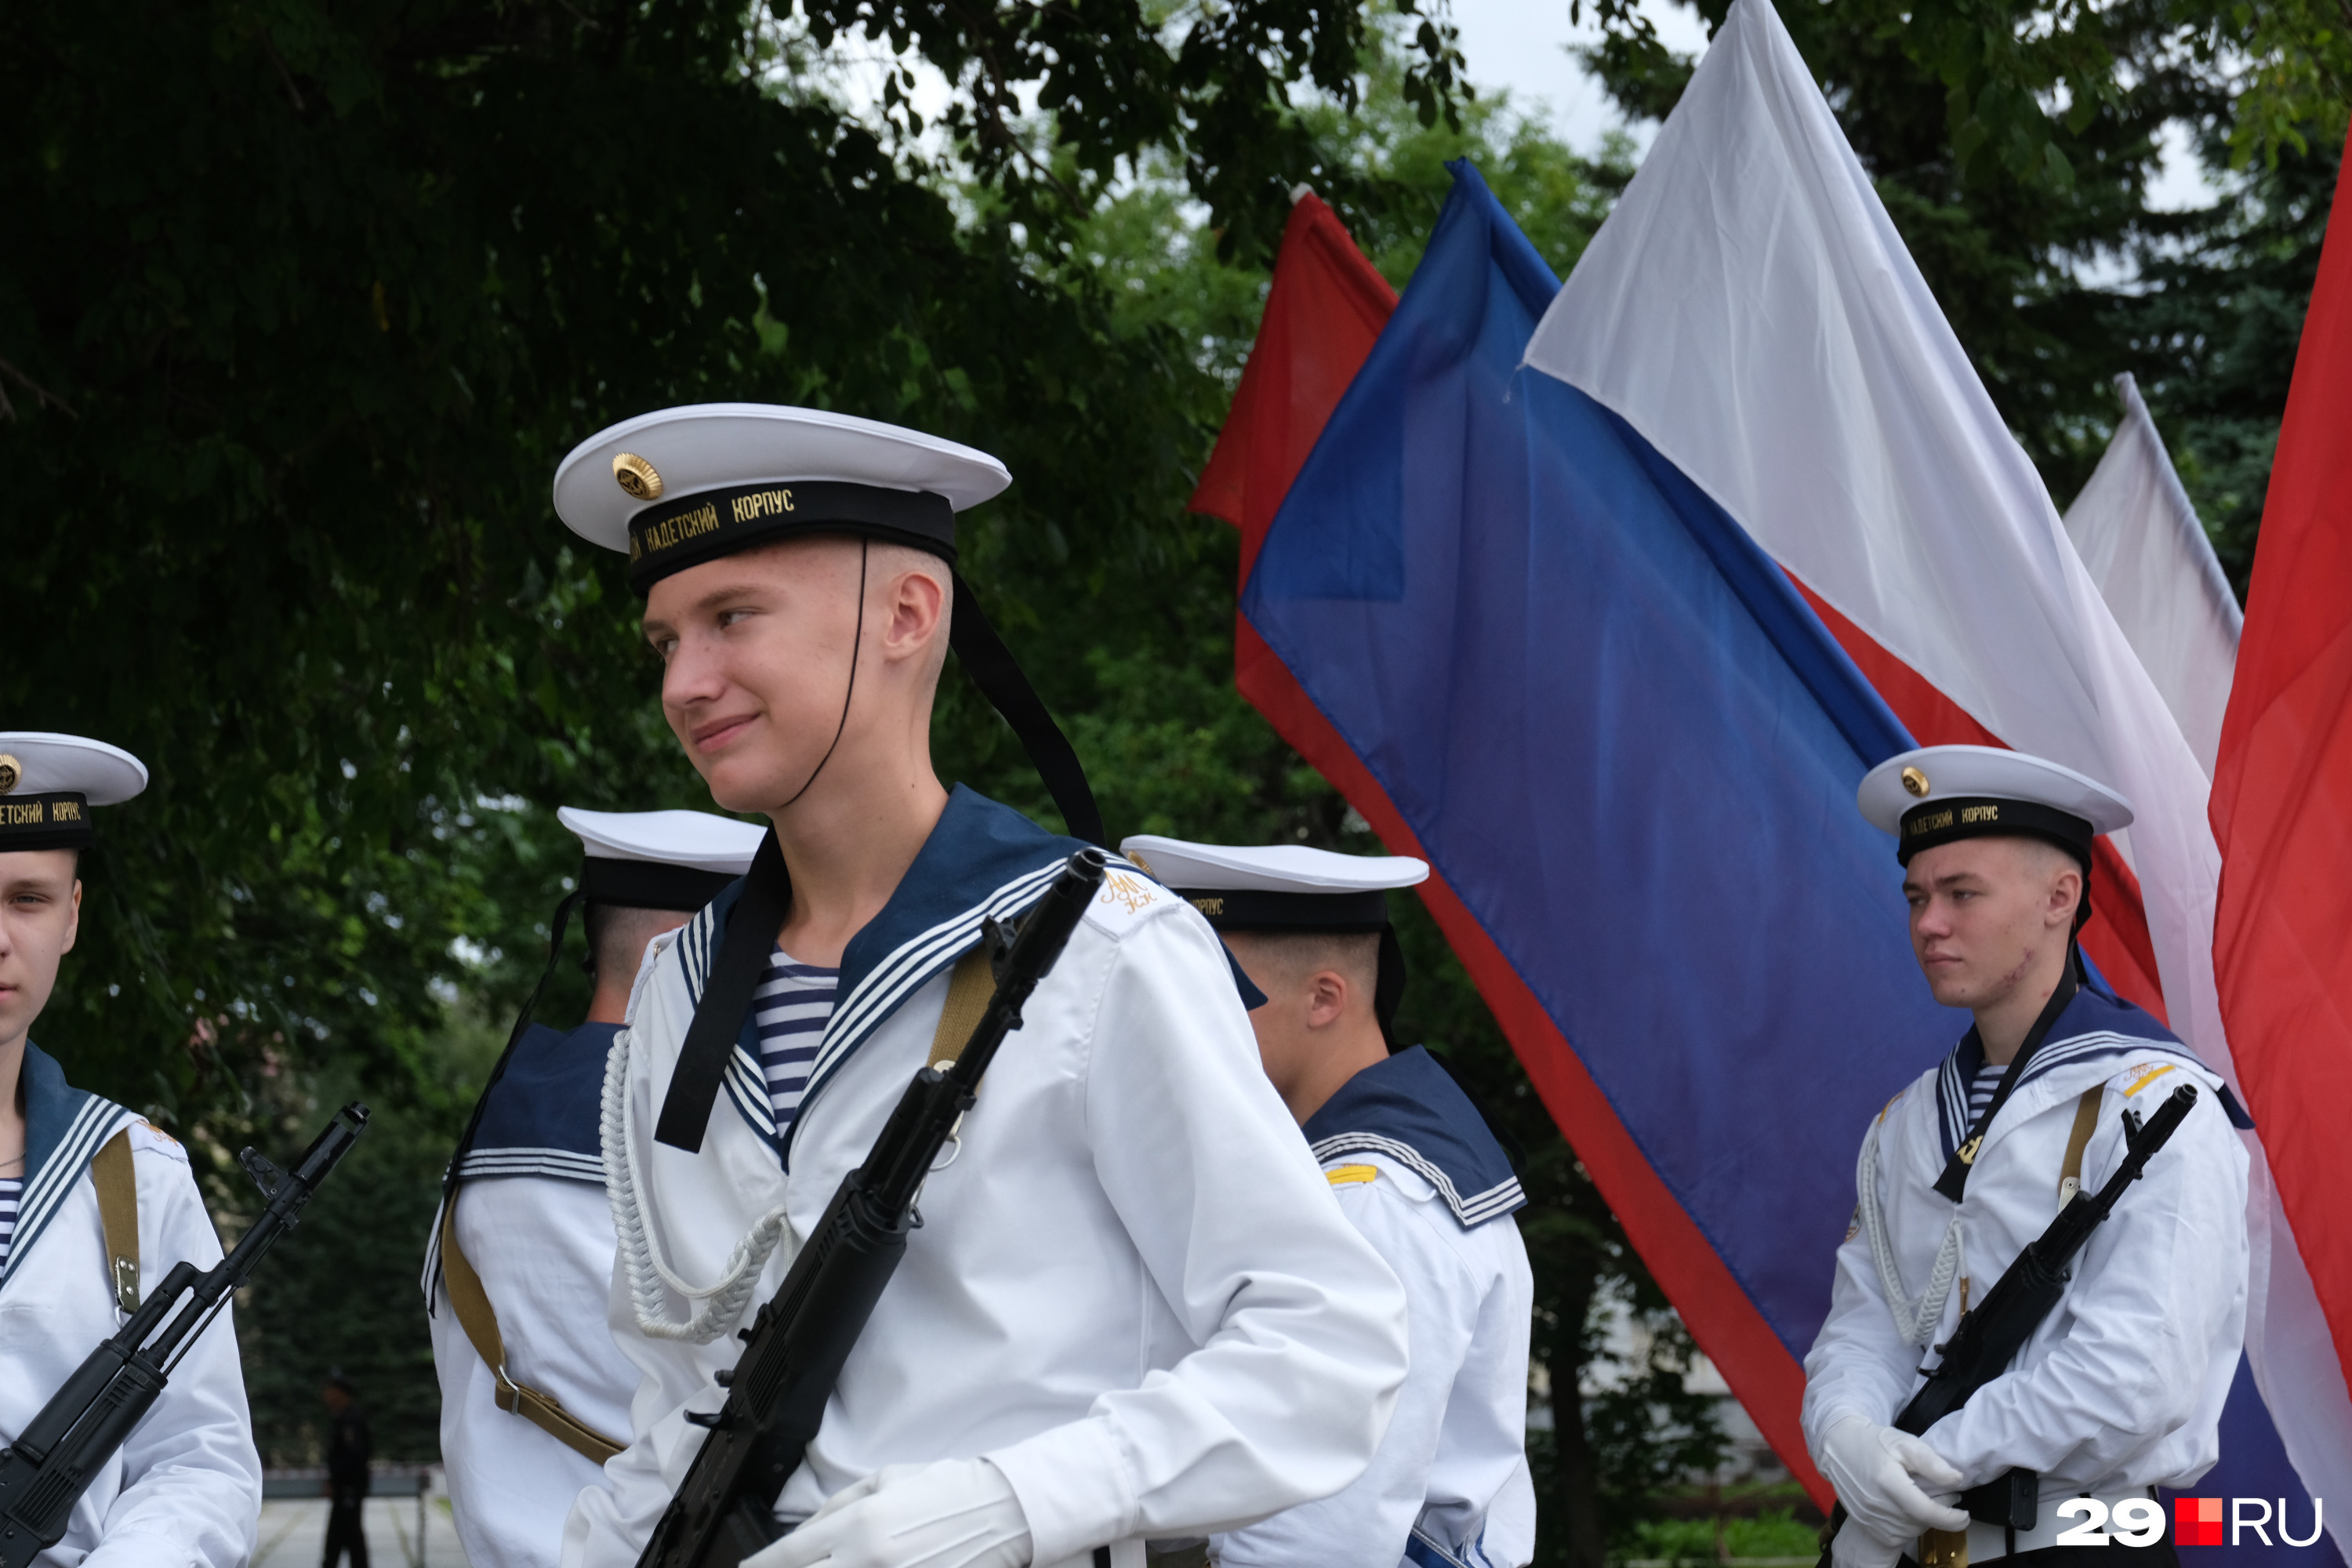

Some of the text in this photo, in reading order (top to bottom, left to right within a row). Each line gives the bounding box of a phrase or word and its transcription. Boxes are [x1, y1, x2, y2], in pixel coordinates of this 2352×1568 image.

[644, 502, 720, 553] КАДЕТСКИЙ
[731, 488, 794, 523] КОРПУС
[52, 801, 82, 822] КОРПУС
[1962, 805, 1998, 824] КОРПУС
[1190, 898, 1224, 916] ОРПУС
